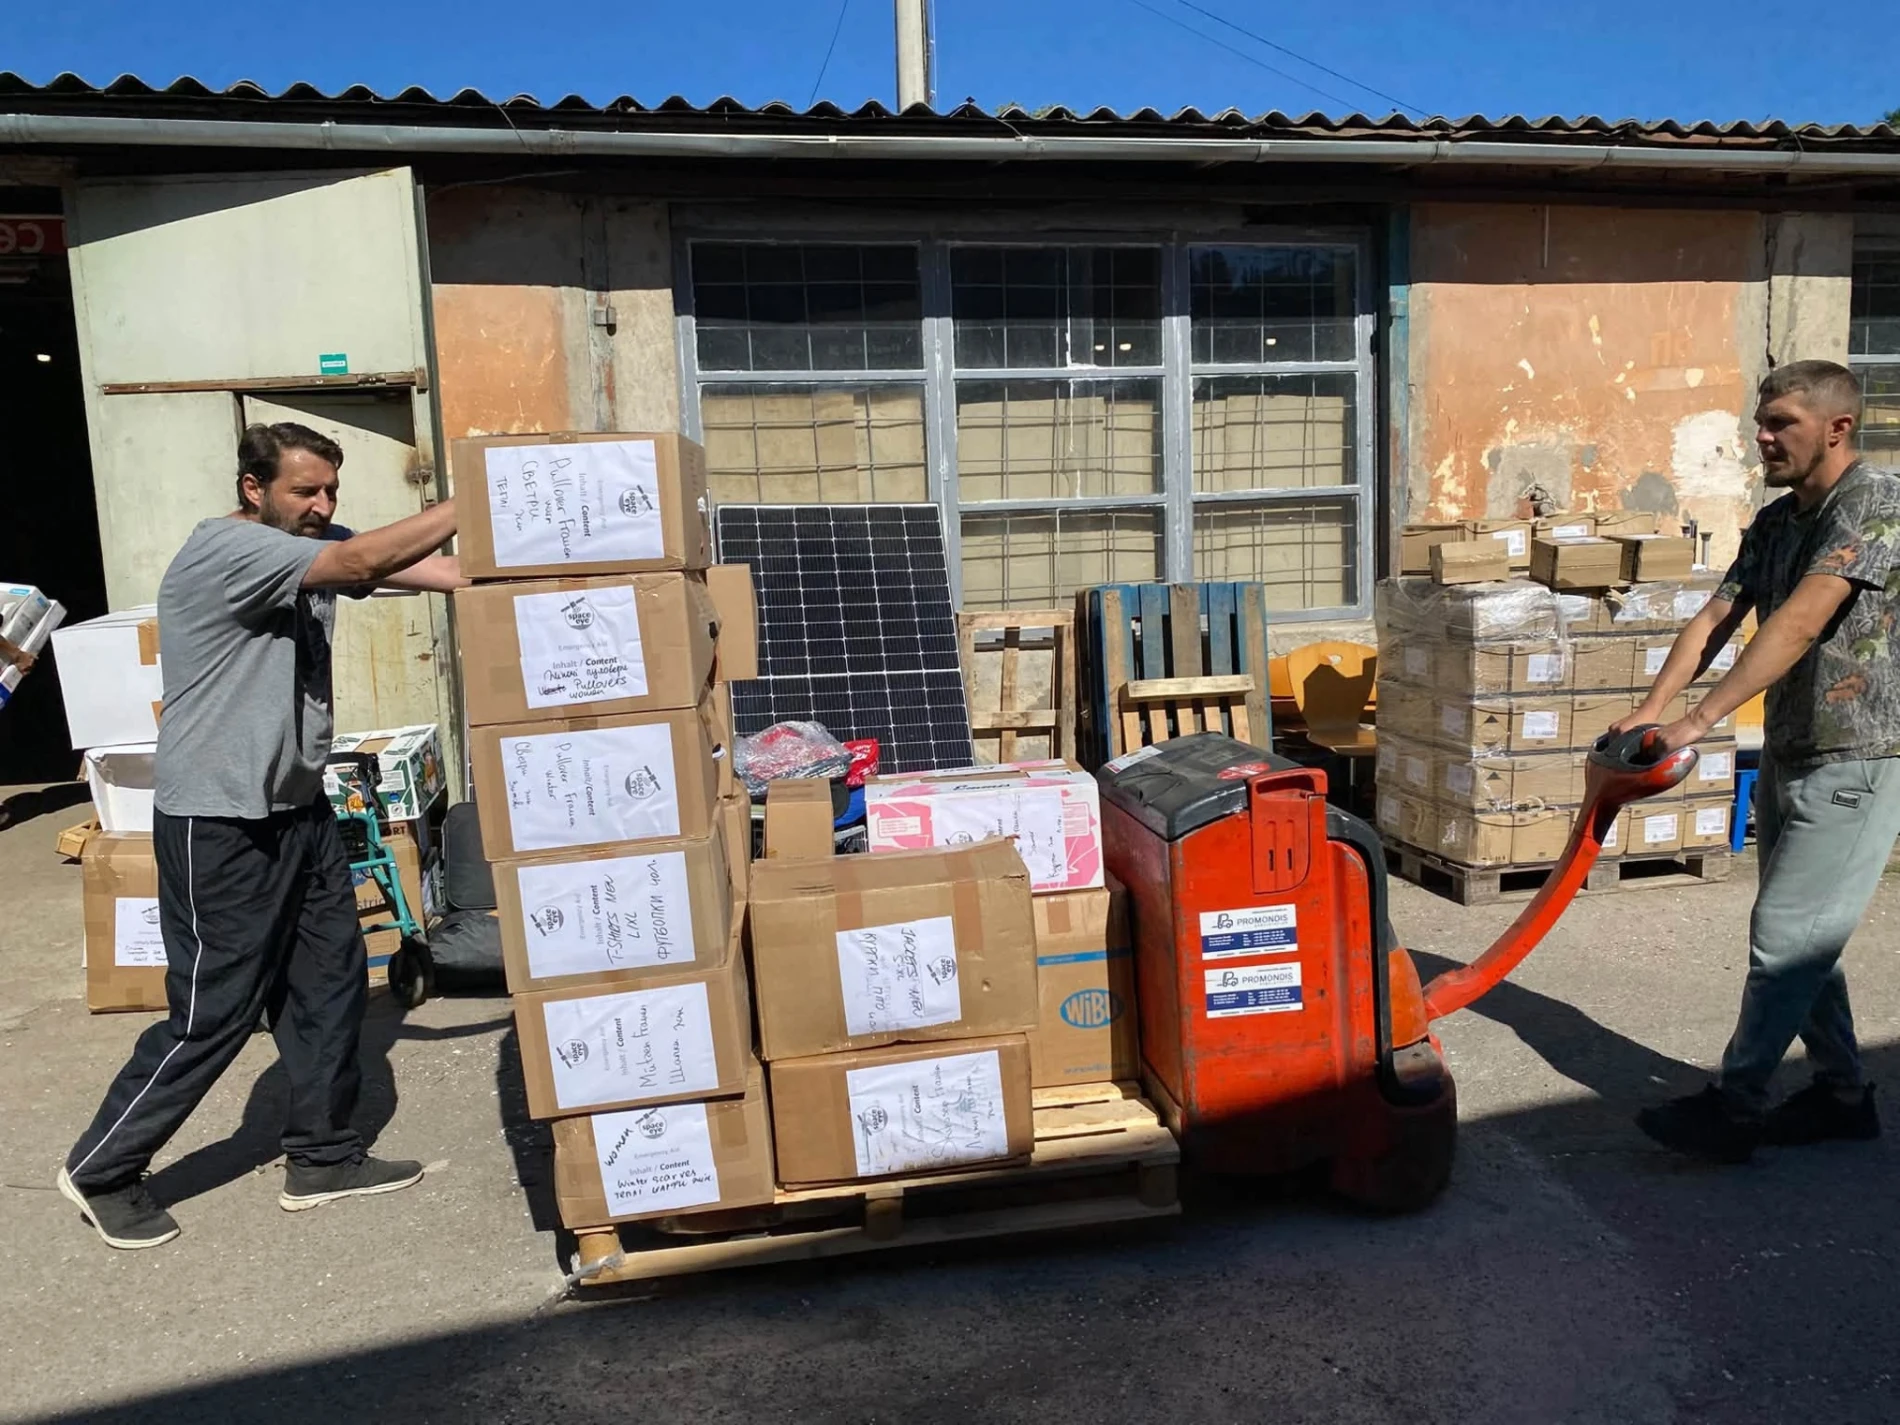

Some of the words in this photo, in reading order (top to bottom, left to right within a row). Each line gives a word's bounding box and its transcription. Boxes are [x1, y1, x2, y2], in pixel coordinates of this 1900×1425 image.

[549, 457, 573, 517] Pullover
[629, 491, 638, 515] space
[581, 504, 591, 538] Content
[558, 518, 576, 559] Frauen
[568, 611, 592, 623] space
[575, 616, 590, 626] eye
[552, 660, 578, 670] Inhalt
[585, 656, 618, 667] Content
[573, 676, 628, 691] Pullovers
[555, 742, 573, 784] Pullover
[630, 780, 639, 796] eye
[636, 772, 645, 797] space
[590, 884, 600, 915] Content
[603, 874, 617, 904] MEN
[546, 908, 554, 930] space
[551, 909, 559, 924] eye
[1237, 914, 1288, 926] PROMONDIS
[606, 912, 624, 965] T-SHIRTS
[1242, 972, 1294, 984] PROMONDIS
[613, 1017, 624, 1047] Content
[631, 1004, 649, 1039] Frauen
[571, 1042, 580, 1063] space
[576, 1043, 584, 1057] eye
[912, 1084, 922, 1114] Content
[642, 1121, 665, 1132] space
[648, 1127, 664, 1136] eye
[605, 1127, 634, 1167] WOMEN
[659, 1160, 691, 1172] Content
[617, 1177, 648, 1189] Winter
